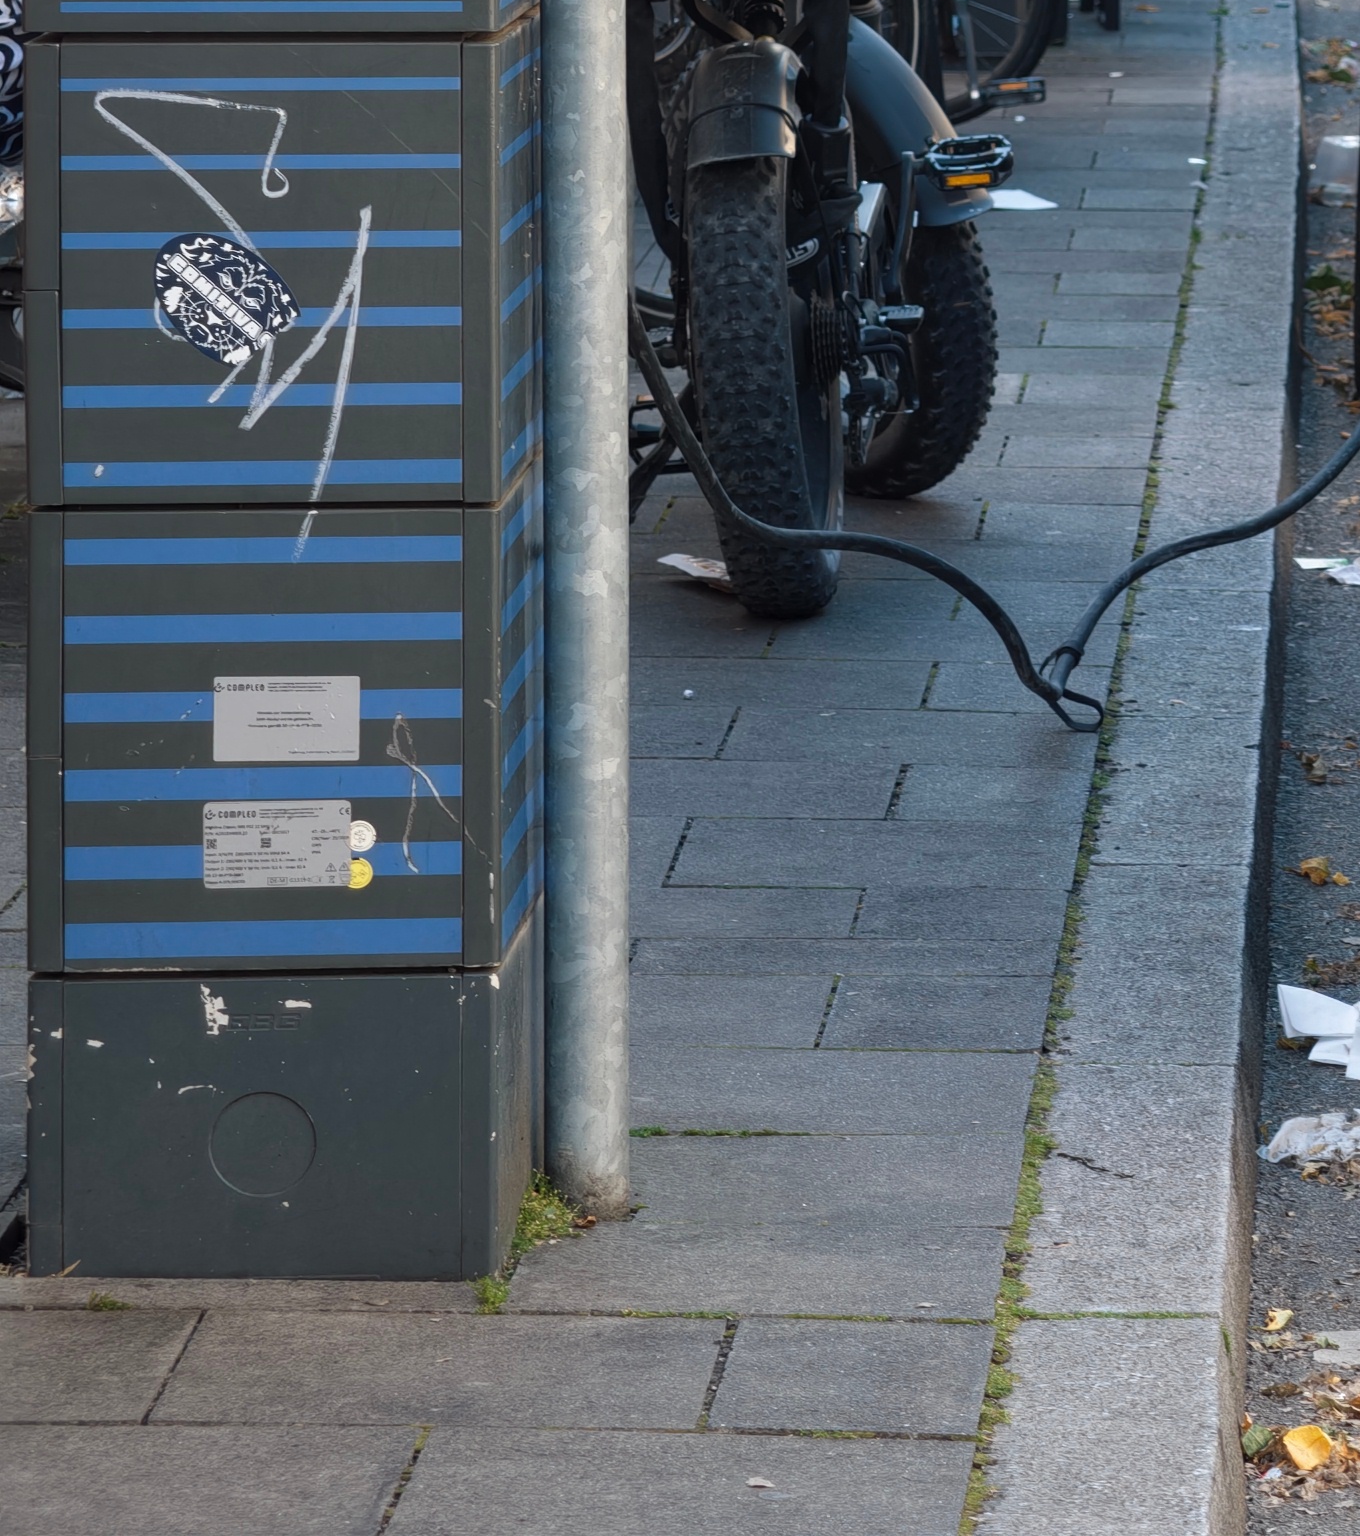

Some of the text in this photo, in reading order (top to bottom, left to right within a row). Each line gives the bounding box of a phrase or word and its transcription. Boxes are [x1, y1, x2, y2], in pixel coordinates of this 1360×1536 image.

[167, 253, 263, 341] COMITIVA
[226, 683, 265, 692] COMPLEO
[218, 810, 256, 819] COMPLEO
